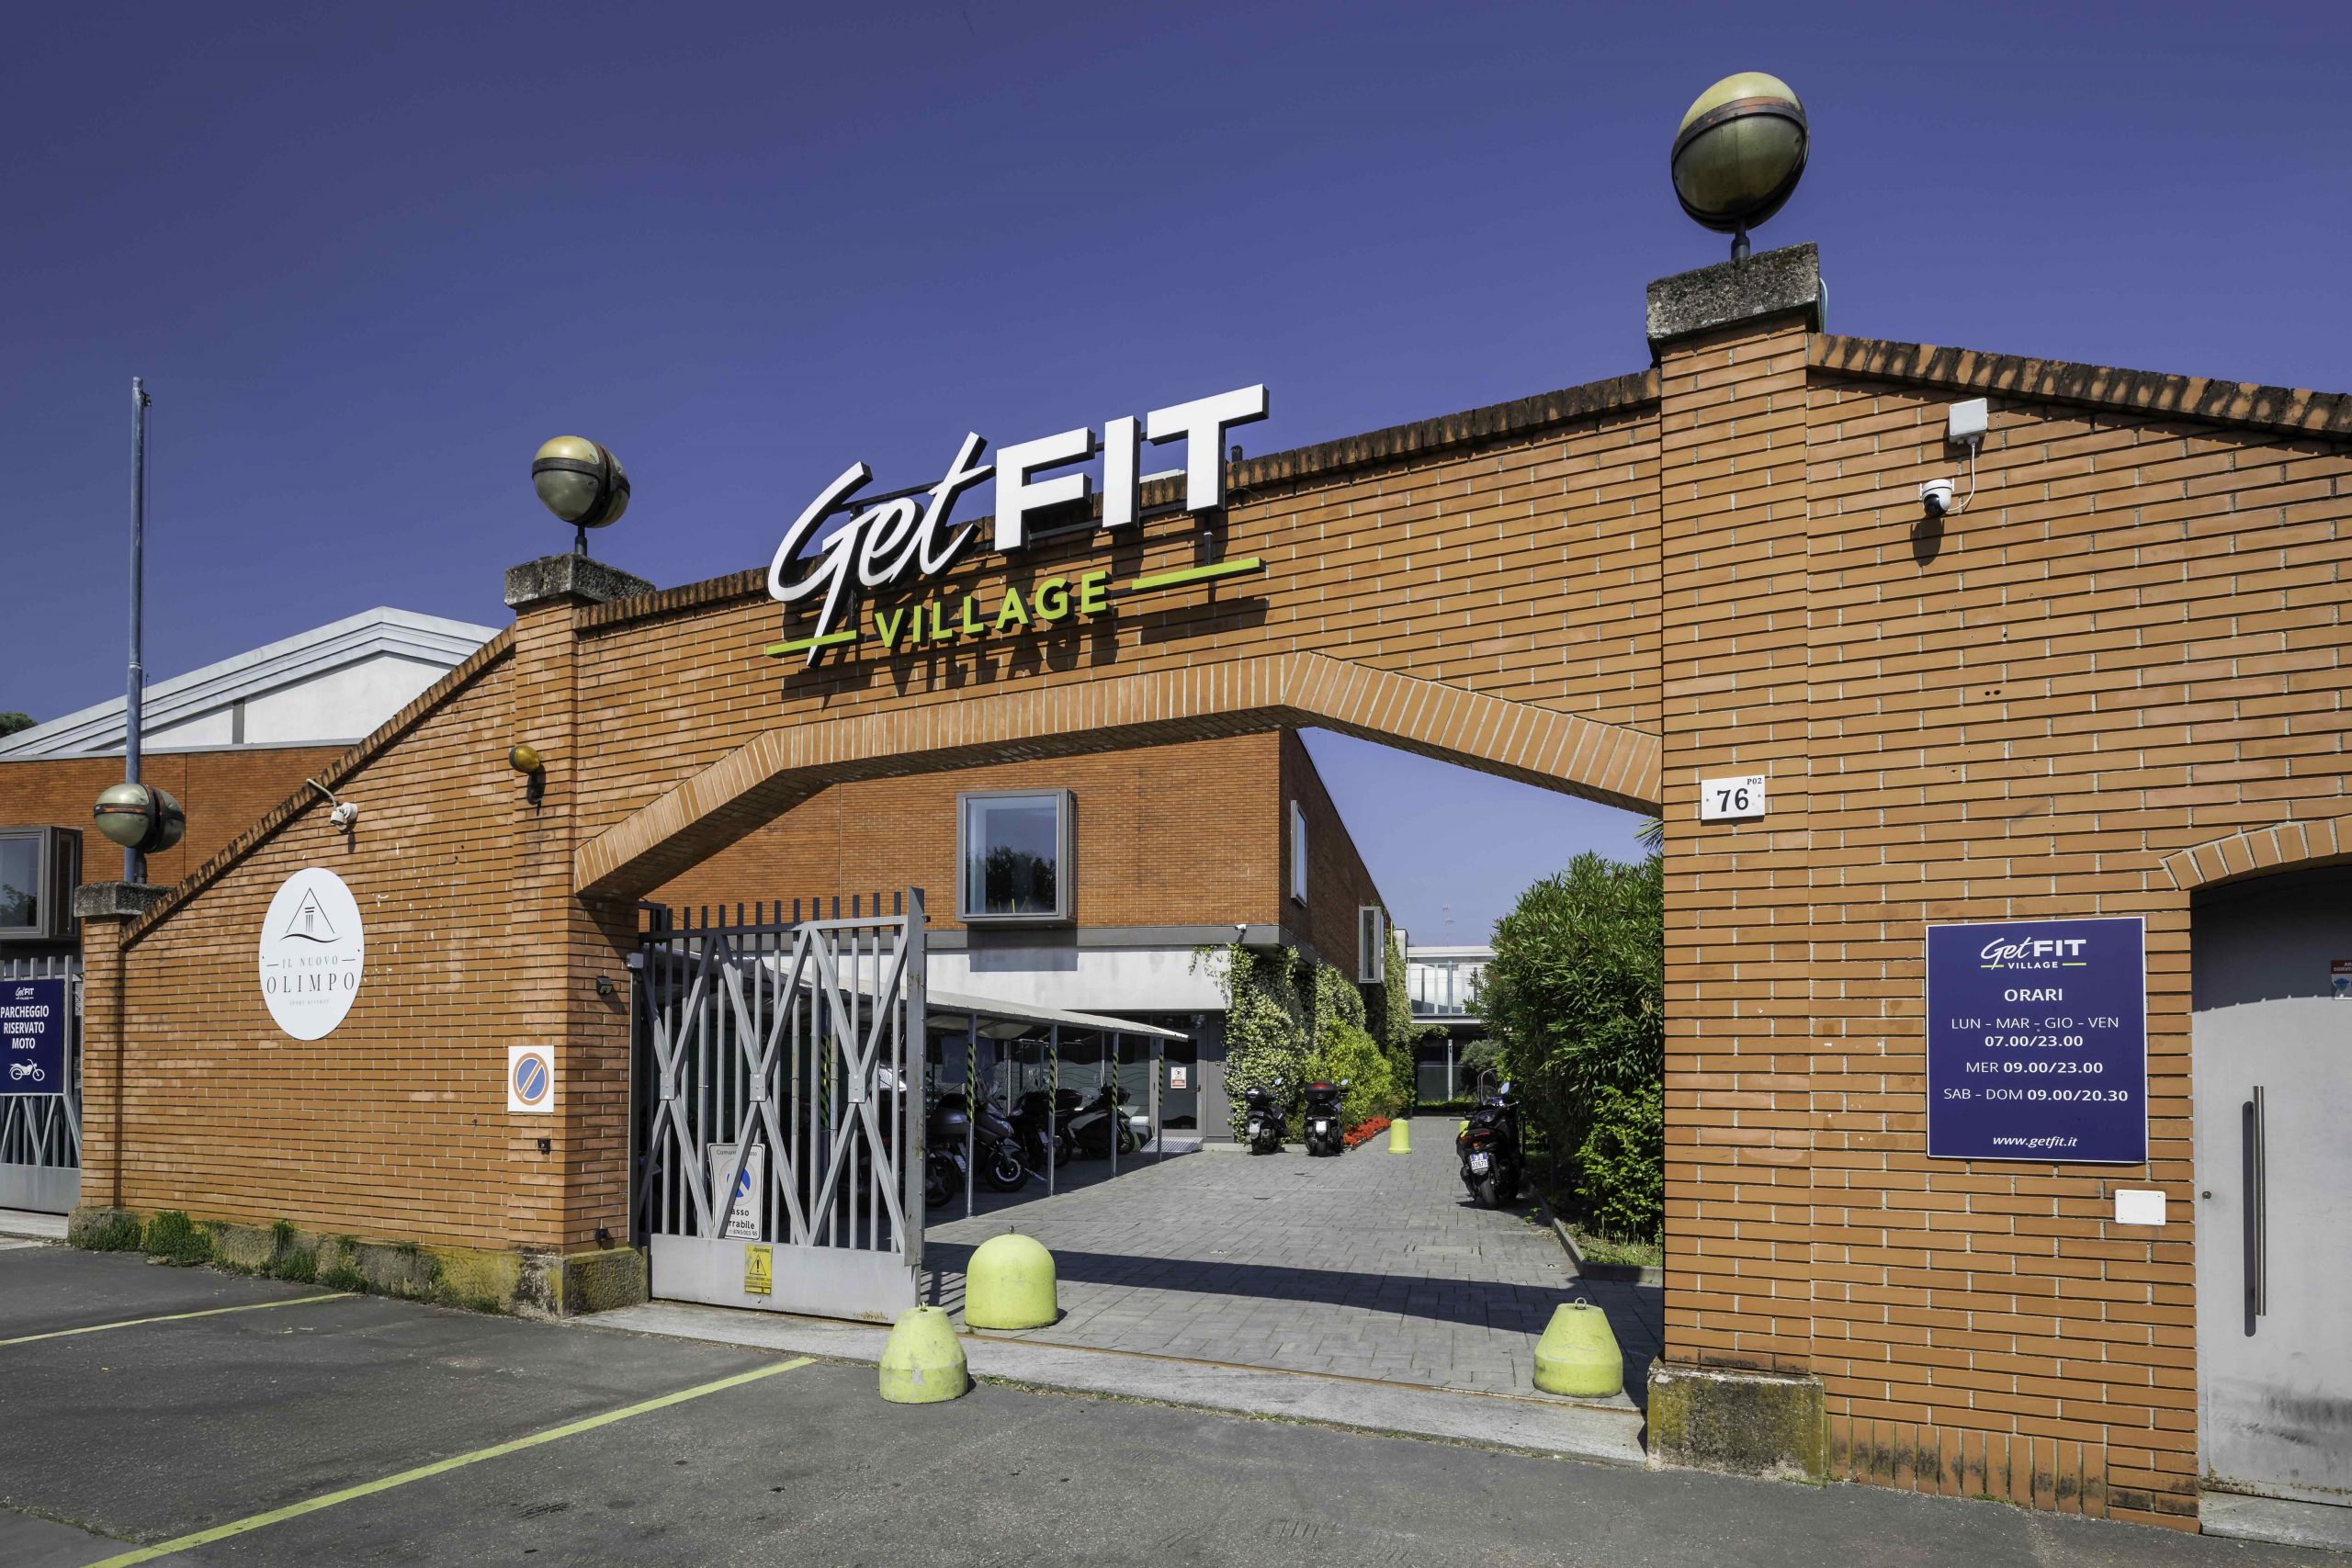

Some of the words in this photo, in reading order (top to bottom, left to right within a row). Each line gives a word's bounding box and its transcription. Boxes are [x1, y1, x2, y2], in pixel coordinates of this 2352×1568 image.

[875, 570, 1113, 648] VILLAGE
[1716, 787, 1749, 812] 76
[282, 958, 292, 968] IL
[300, 955, 338, 966] NUOVO
[2007, 961, 2058, 969] VILLAGE
[266, 971, 355, 994] OLIMPO
[2004, 988, 2064, 1001] ORARI
[0, 1005, 50, 1019] PARCHEGGIO
[4, 1021, 45, 1034] RISERVATO
[1951, 1018, 1981, 1029] LUN
[1996, 1018, 2030, 1029] MAR
[2044, 1017, 2073, 1029] GIO
[2087, 1016, 2120, 1028] VEN
[12, 1037, 36, 1049] MOTO
[1984, 1035, 2084, 1047] 07.00/23.00
[1966, 1062, 1999, 1073] MER
[2003, 1062, 2103, 1074] 09.00/23.00
[1943, 1088, 1972, 1100] SAB
[1985, 1089, 2023, 1100] DOM
[2027, 1089, 2129, 1101] 09.00/20.30
[1993, 1135, 2078, 1148] www.getfit.it
[730, 1208, 750, 1217] asso
